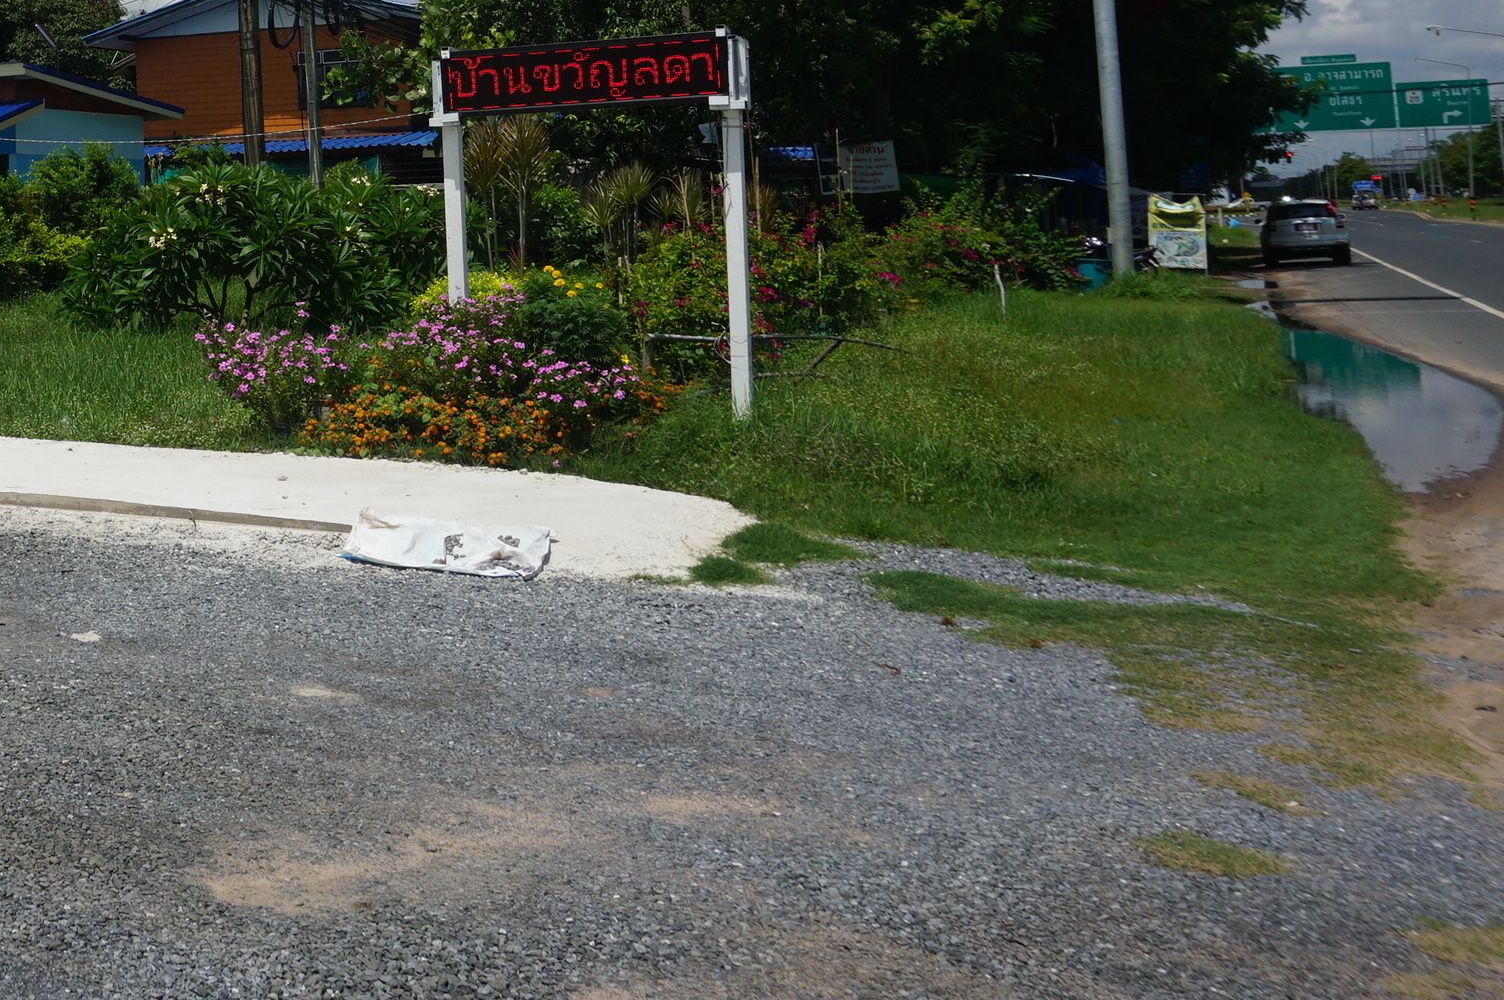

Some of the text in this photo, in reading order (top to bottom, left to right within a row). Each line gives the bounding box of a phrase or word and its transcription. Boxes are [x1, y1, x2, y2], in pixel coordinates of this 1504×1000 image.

[452, 51, 714, 97] บ้านขวัญลดา
